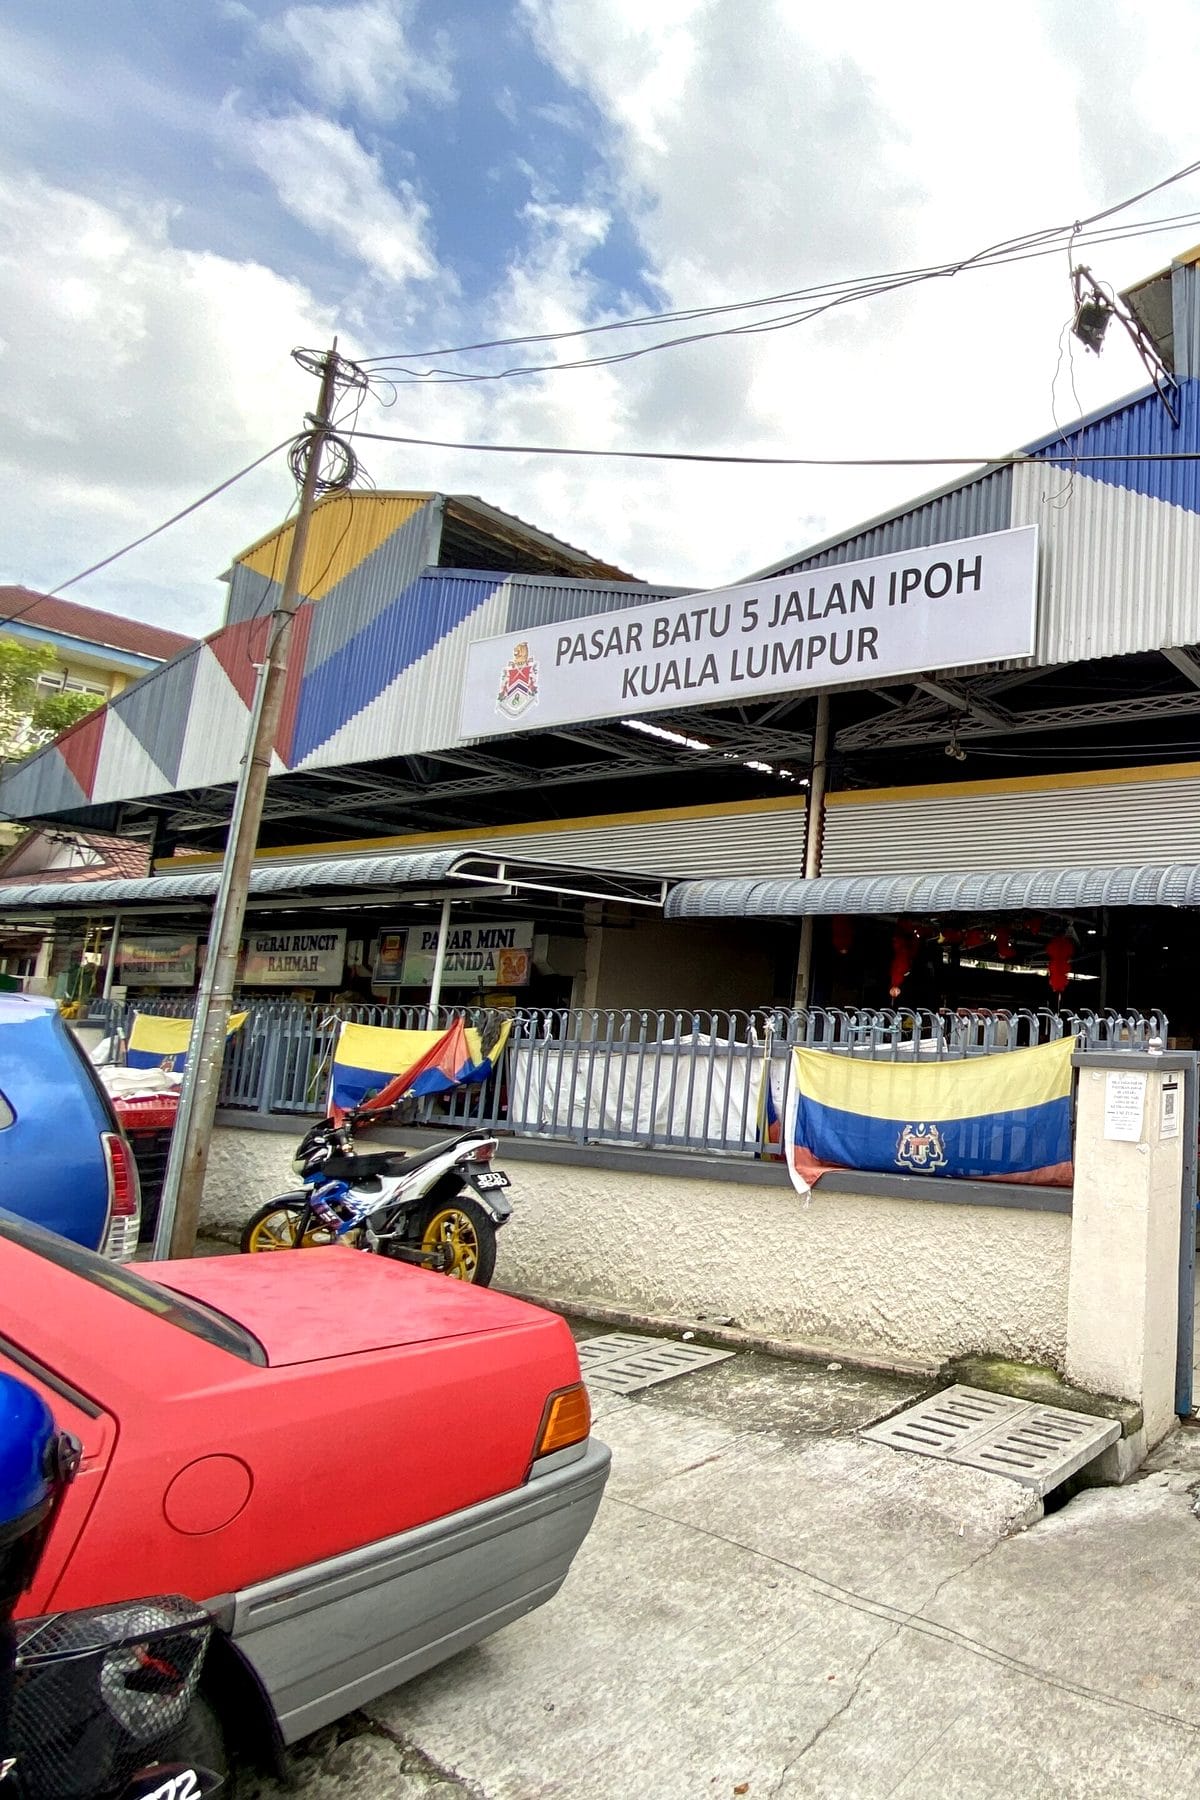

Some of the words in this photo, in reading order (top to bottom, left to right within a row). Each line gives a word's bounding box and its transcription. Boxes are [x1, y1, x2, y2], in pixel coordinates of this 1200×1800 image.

[555, 622, 643, 667] PASAR
[652, 604, 731, 649] BATU
[741, 598, 759, 633] 5
[768, 575, 875, 628] JALAN
[888, 555, 982, 606] IPOH
[621, 653, 719, 699] KUALA
[730, 626, 879, 682] LUMPUR
[256, 935, 291, 952] GERAI
[292, 934, 338, 951] RUNCIT
[421, 929, 472, 950] PAAR
[476, 928, 516, 949] MINI
[268, 955, 319, 972] RAHMAH
[433, 951, 496, 971] ZNIDA
